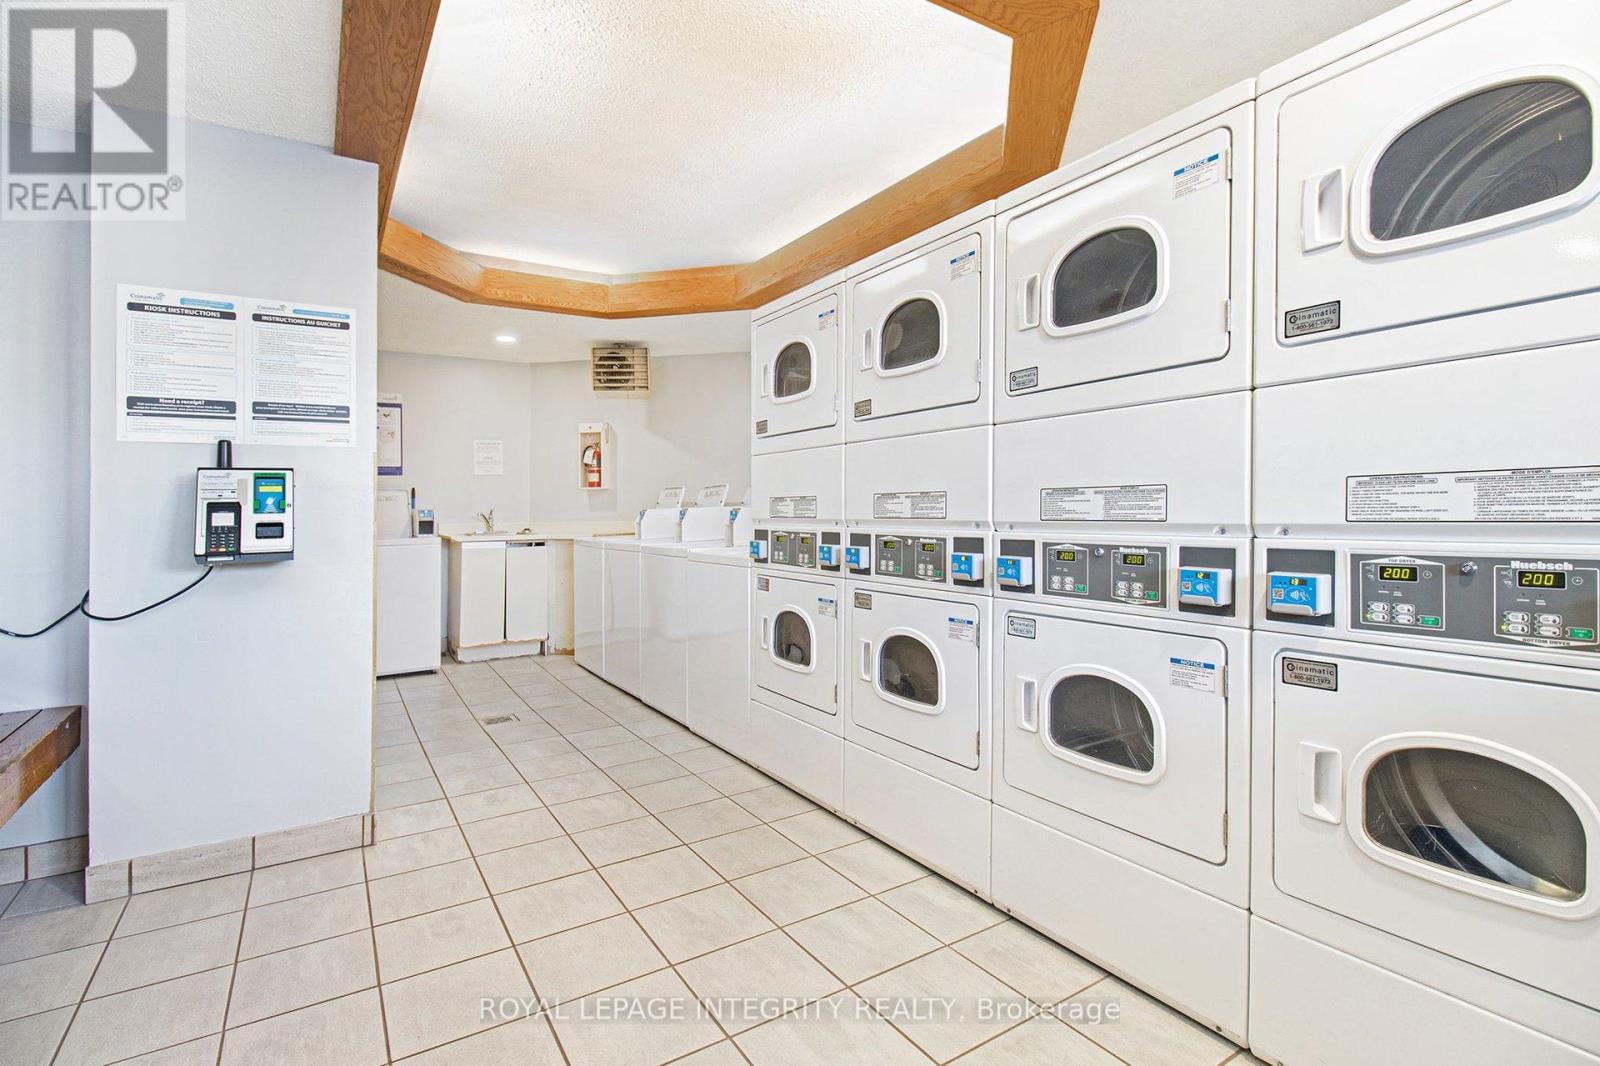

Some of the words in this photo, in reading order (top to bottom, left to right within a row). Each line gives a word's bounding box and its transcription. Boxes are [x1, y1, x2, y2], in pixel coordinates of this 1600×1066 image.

[168, 308, 221, 318] INSTRUCTIONS
[262, 316, 306, 324] INSTRUCTIONS
[1060, 552, 1073, 560] 200
[1127, 556, 1142, 564] 200
[1511, 560, 1573, 571] Huebsch
[1383, 568, 1410, 578] 200
[1522, 573, 1554, 586] 200
